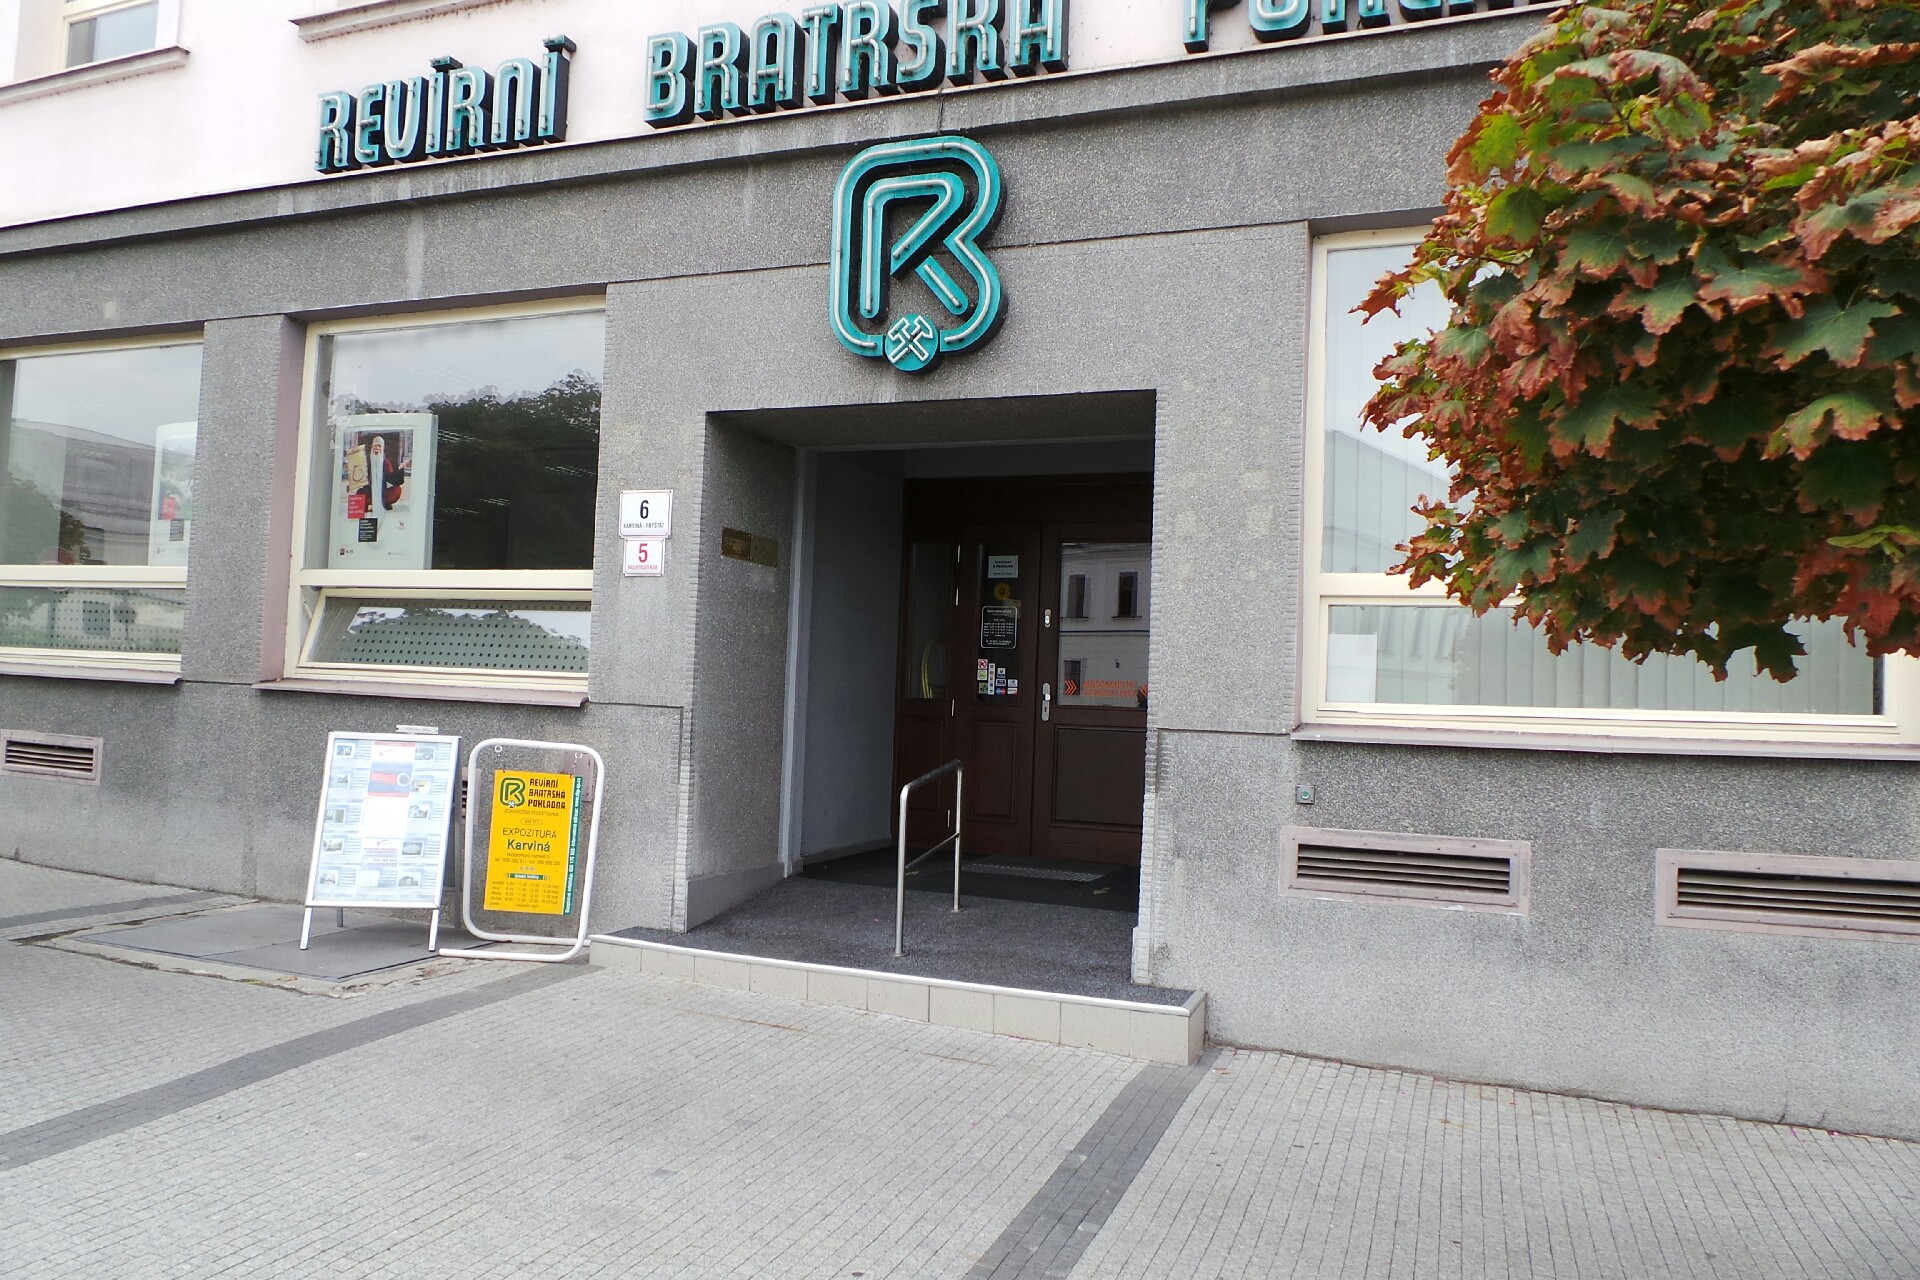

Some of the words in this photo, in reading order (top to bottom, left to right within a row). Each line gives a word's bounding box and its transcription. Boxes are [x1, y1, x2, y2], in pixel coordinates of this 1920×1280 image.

[314, 35, 570, 172] REVÍRNÍ
[640, 500, 649, 519] 6
[638, 543, 648, 563] 5
[502, 827, 556, 839] EXPOZITURA
[507, 838, 550, 852] Karviná
